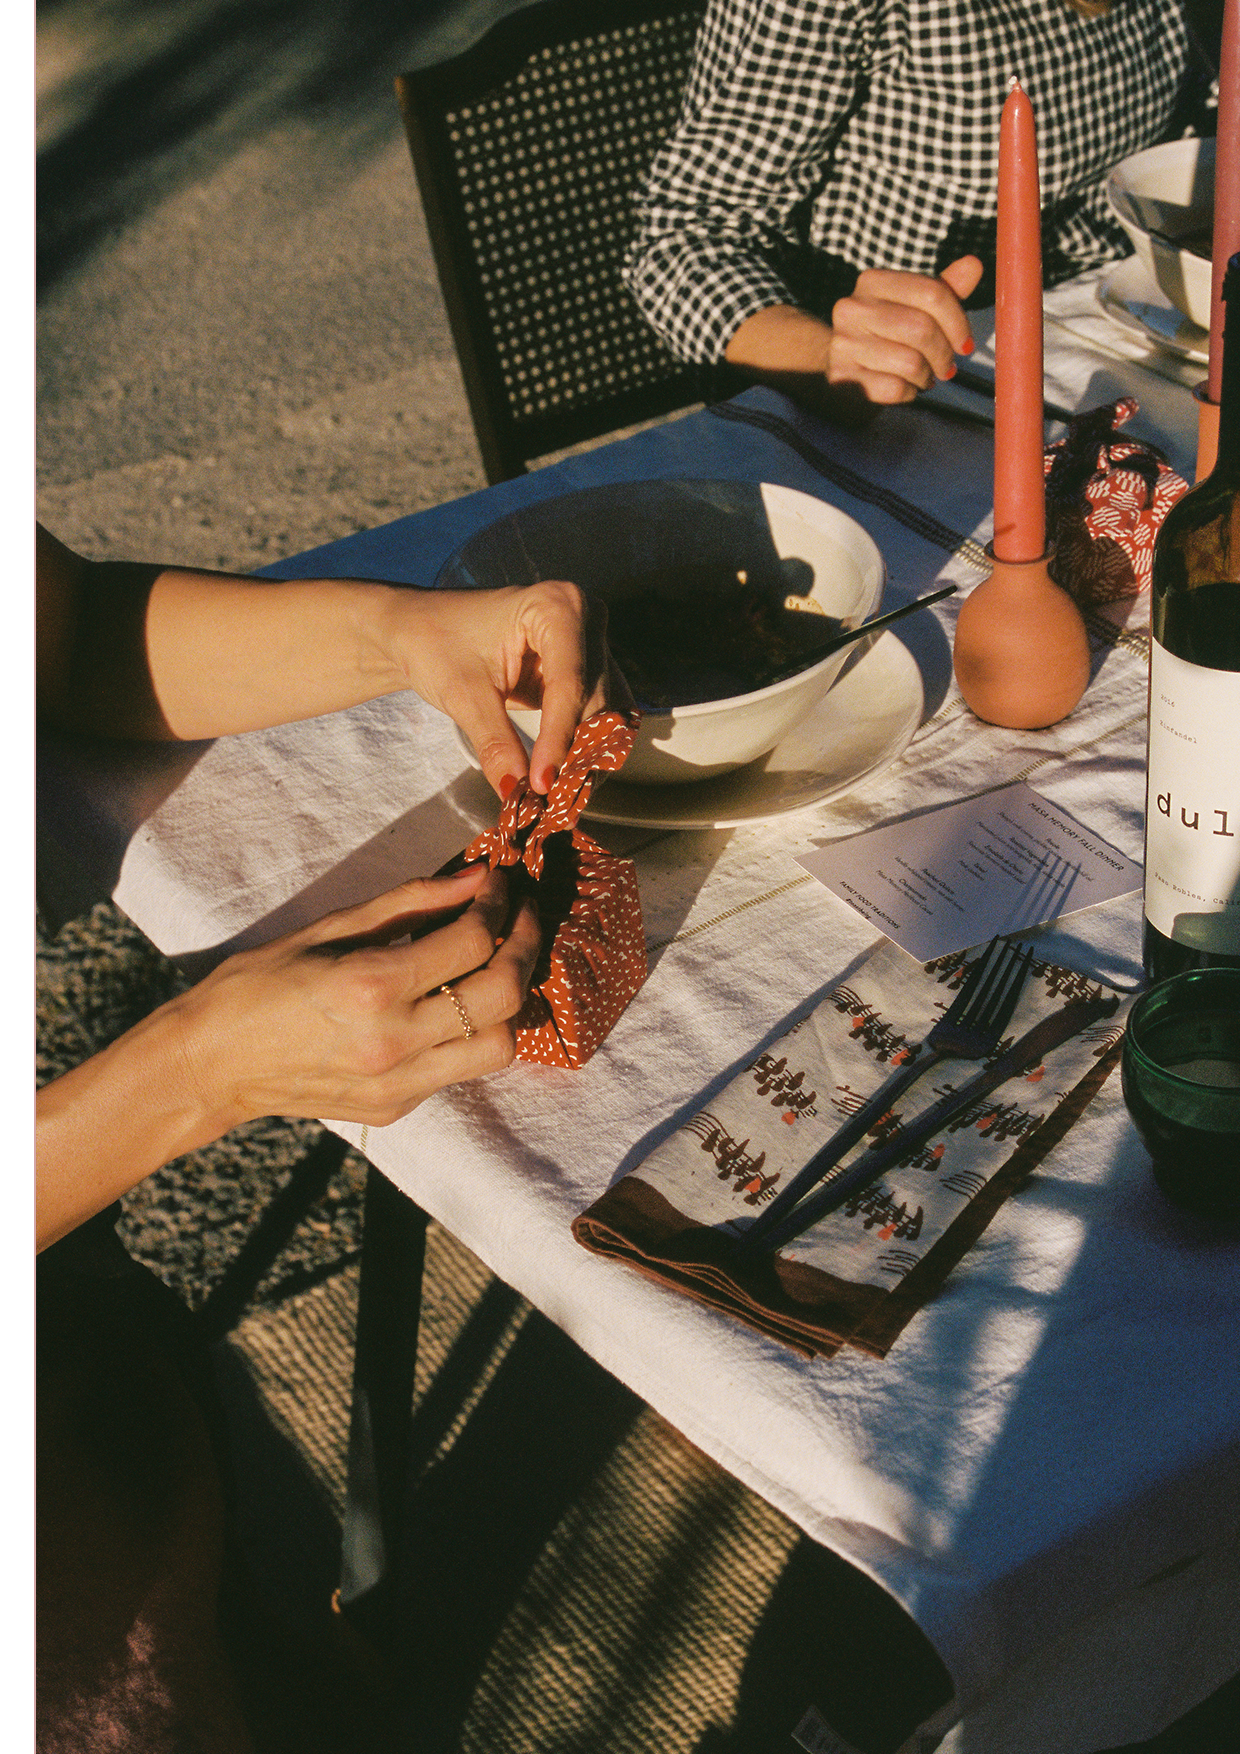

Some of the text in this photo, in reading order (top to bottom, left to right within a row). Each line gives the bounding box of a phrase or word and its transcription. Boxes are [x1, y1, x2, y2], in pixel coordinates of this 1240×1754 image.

[1028, 803, 1051, 817] MASA
[1048, 817, 1081, 839] MEMORY
[1078, 839, 1098, 851] FALL
[1094, 851, 1125, 870] DINNER
[1156, 792, 1235, 837] dul
[839, 881, 900, 928] FAMILY FOOD TRADITIONS
